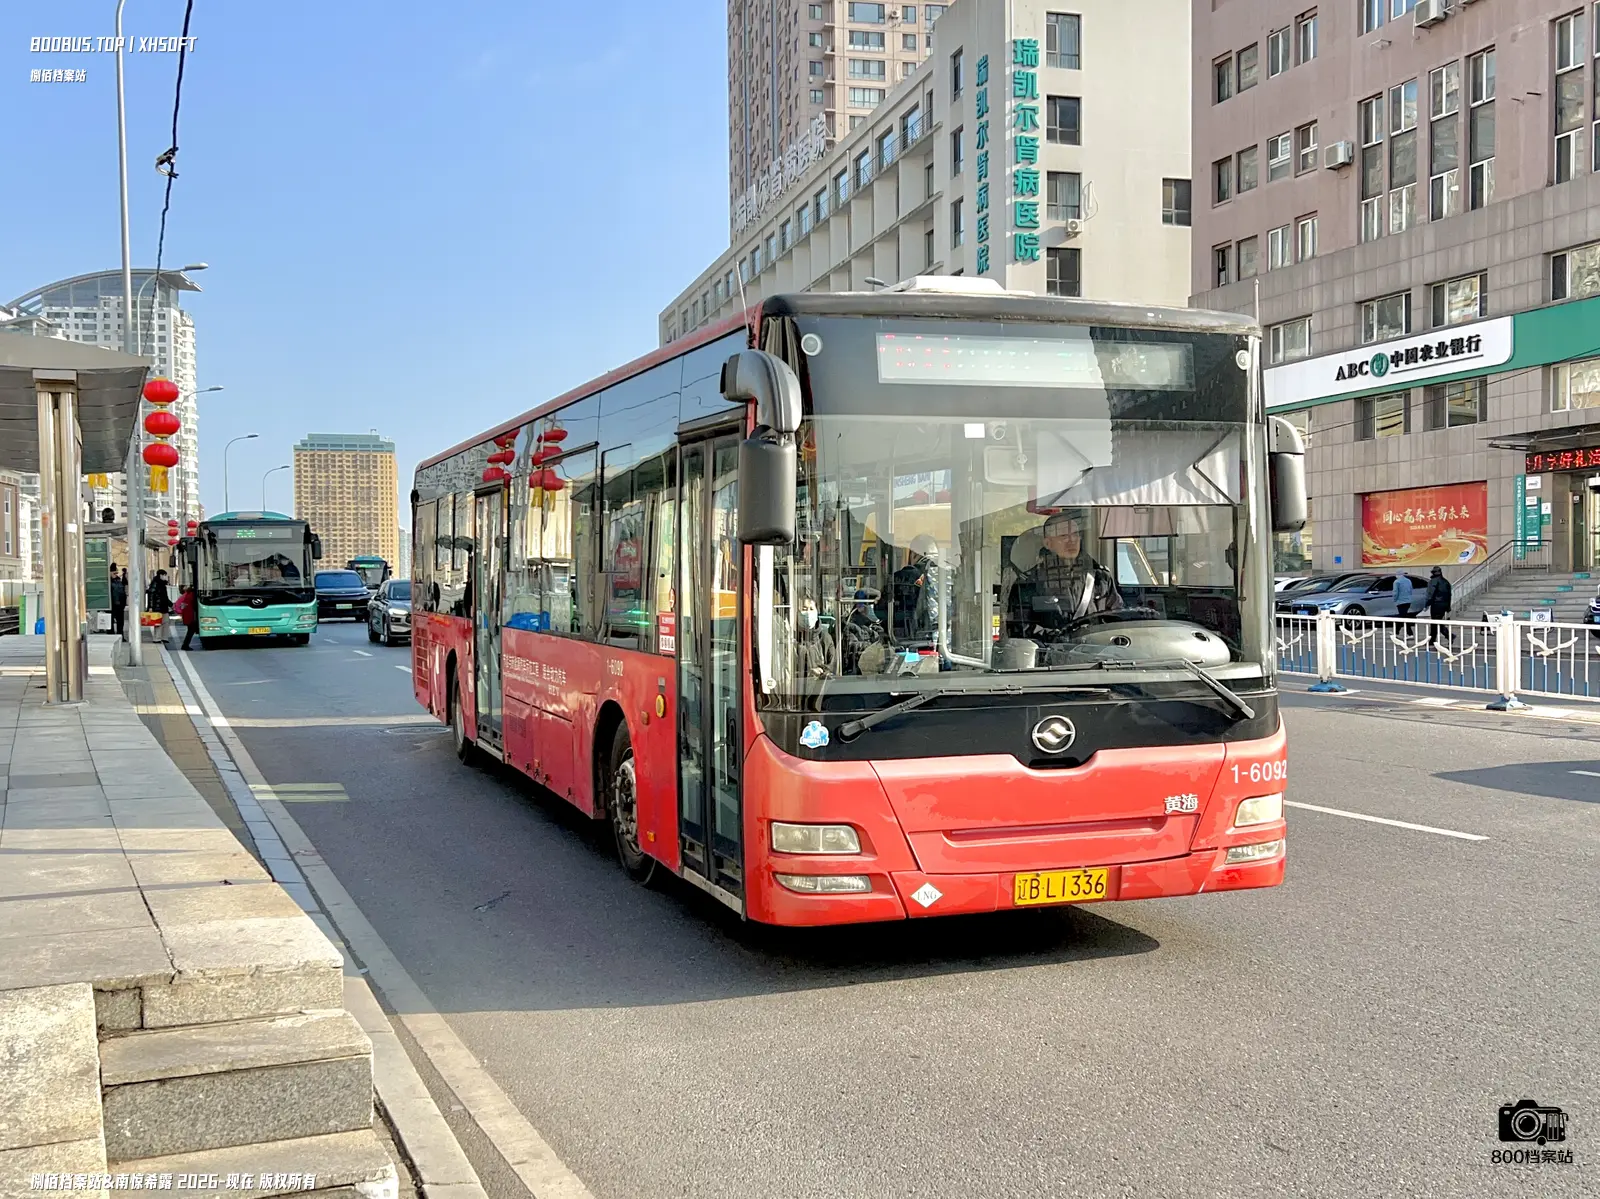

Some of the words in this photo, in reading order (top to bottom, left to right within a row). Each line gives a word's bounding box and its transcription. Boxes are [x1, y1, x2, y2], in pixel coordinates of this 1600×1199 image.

[975, 54, 990, 274] 瑞凯尔肾病医院
[1012, 38, 1040, 261] 瑞凯尔肾病医院
[1335, 360, 1369, 381] ABC
[1390, 334, 1482, 368] 中国农业银行
[1230, 759, 1288, 784] 1-6092
[1164, 793, 1199, 814] 黄海
[917, 890, 937, 901] LNG
